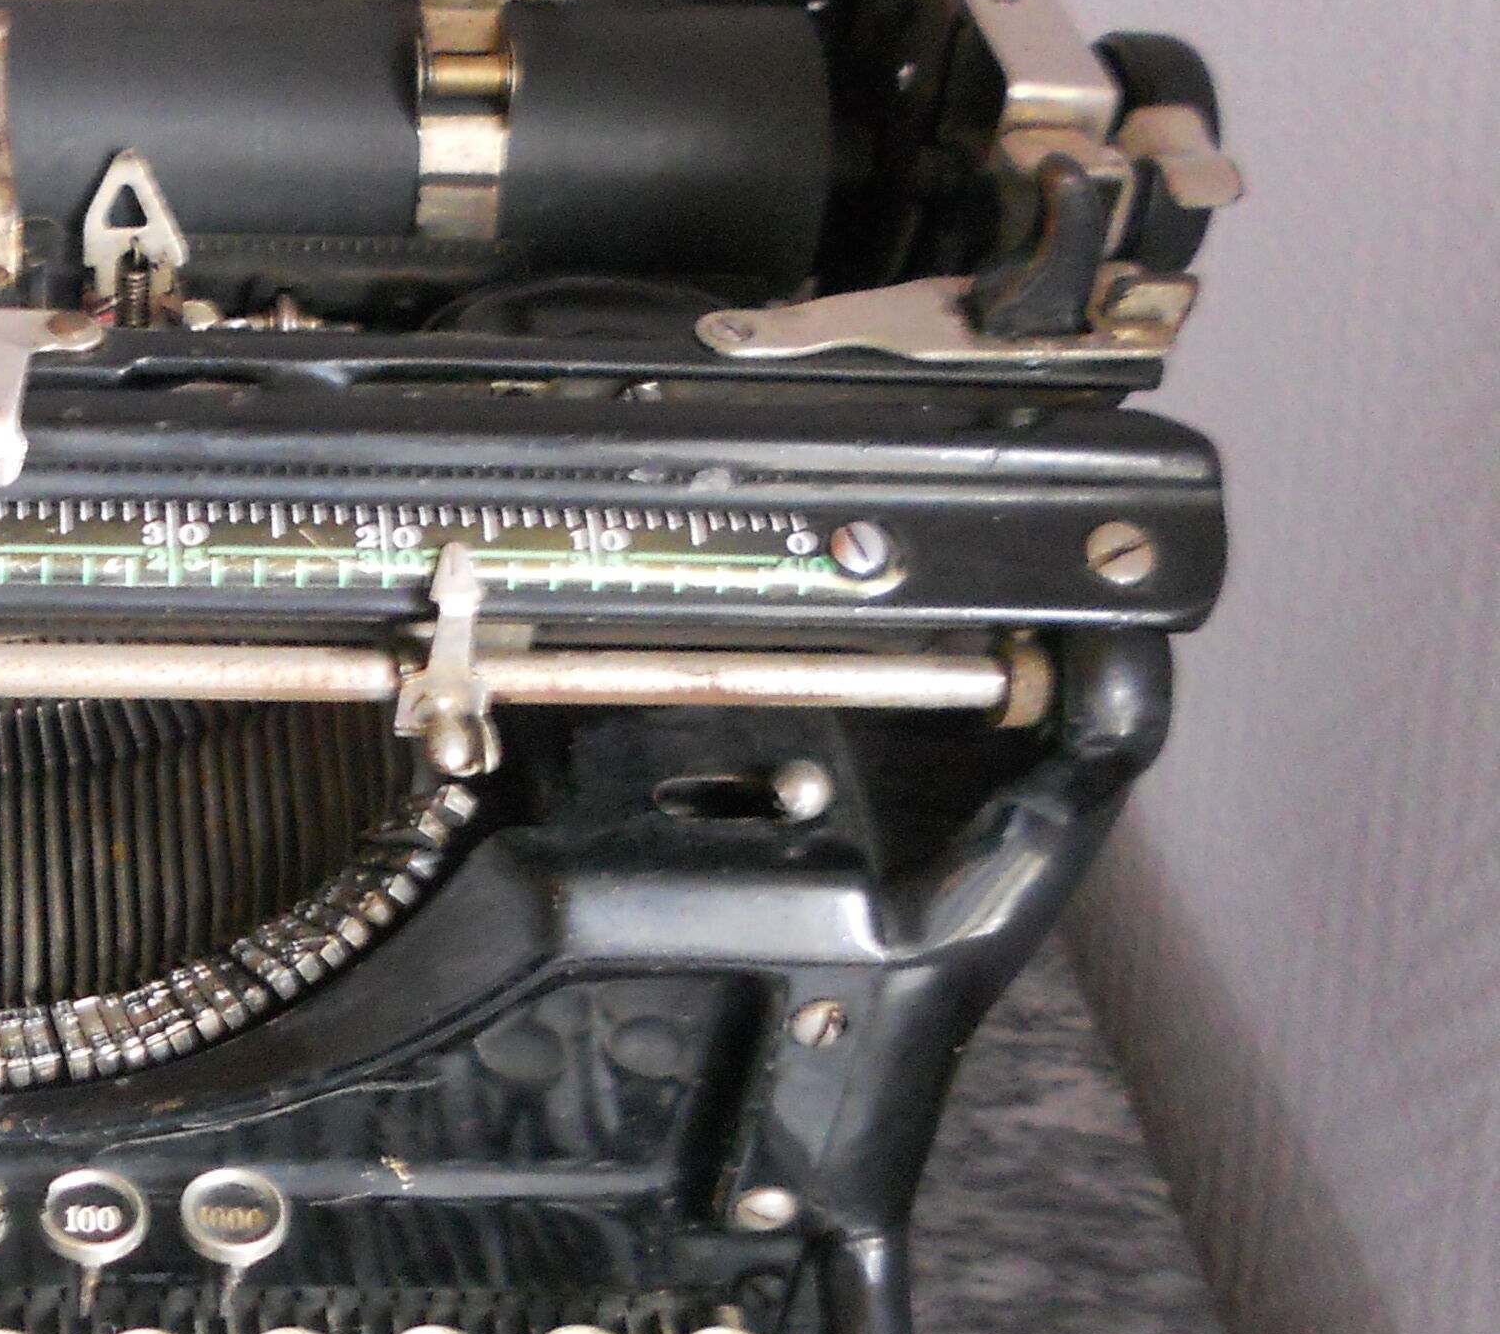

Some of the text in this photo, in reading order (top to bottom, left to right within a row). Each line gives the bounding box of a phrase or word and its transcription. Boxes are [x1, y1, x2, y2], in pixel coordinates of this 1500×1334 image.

[142, 520, 210, 546] 30
[355, 524, 422, 549] 20
[569, 527, 632, 552] 10
[786, 530, 820, 555] 0
[64, 1204, 120, 1235] 100
